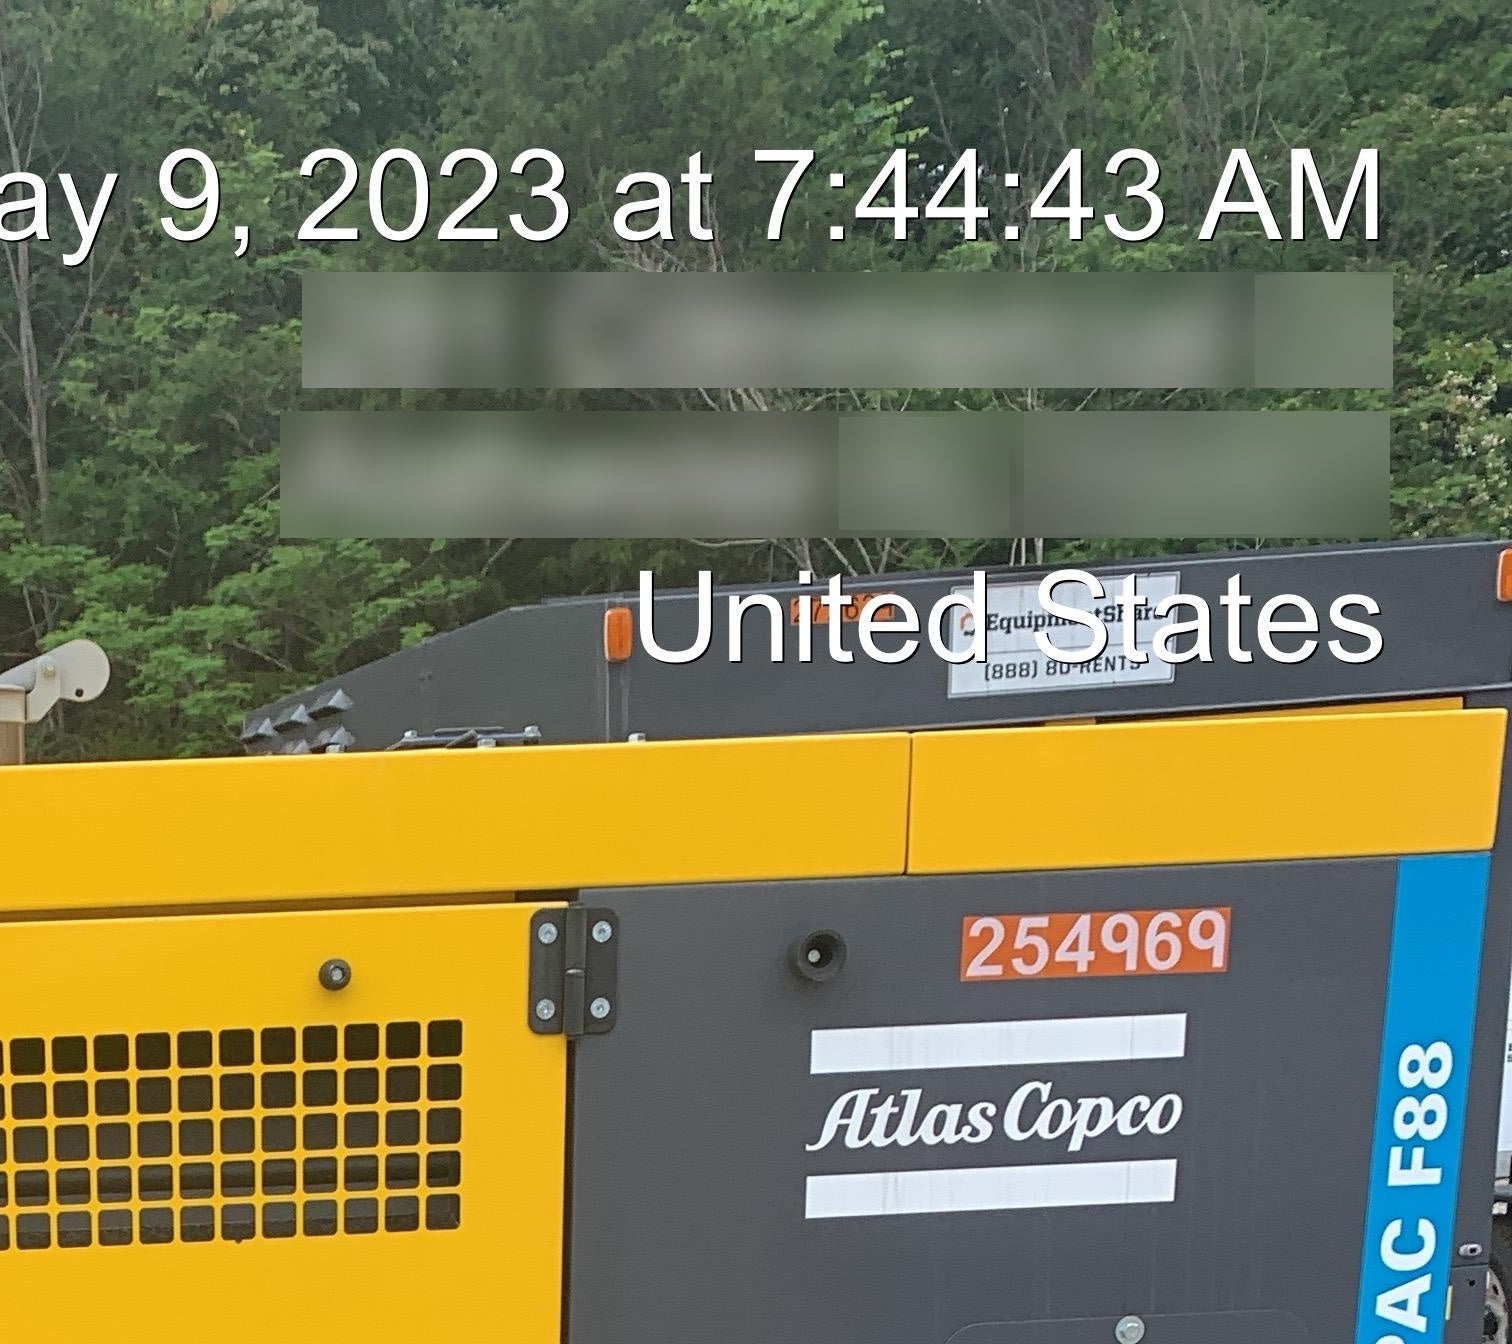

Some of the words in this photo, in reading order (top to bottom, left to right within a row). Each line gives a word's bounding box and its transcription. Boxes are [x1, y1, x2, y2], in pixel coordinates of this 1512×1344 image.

[984, 661, 1038, 681] (888)
[966, 910, 1227, 977] 254969
[805, 1087, 996, 1151] Atlas
[1003, 1080, 1183, 1152] Copco
[1387, 1040, 1453, 1187] F88
